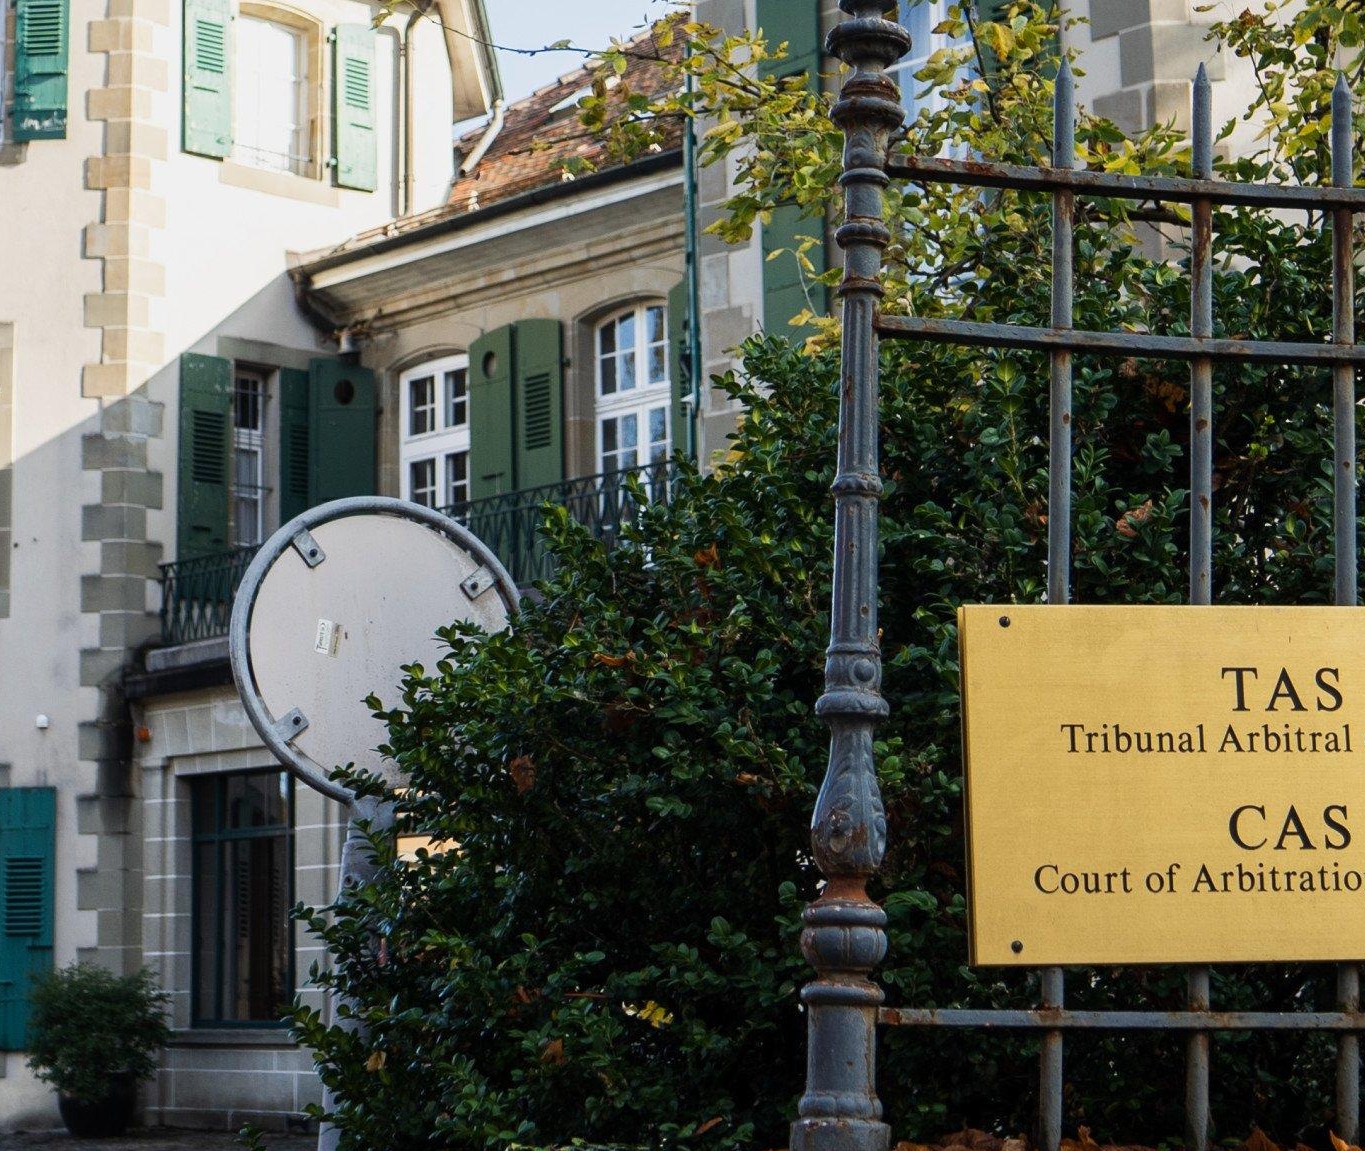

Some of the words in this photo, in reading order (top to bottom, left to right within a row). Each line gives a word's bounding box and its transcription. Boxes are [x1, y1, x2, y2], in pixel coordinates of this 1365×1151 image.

[1221, 667, 1344, 712] TAS
[1060, 723, 1207, 753] Tribunal
[1218, 723, 1352, 753] Arbitral
[1228, 804, 1352, 851] CAS
[1034, 864, 1133, 895] Court
[1145, 863, 1181, 894] of
